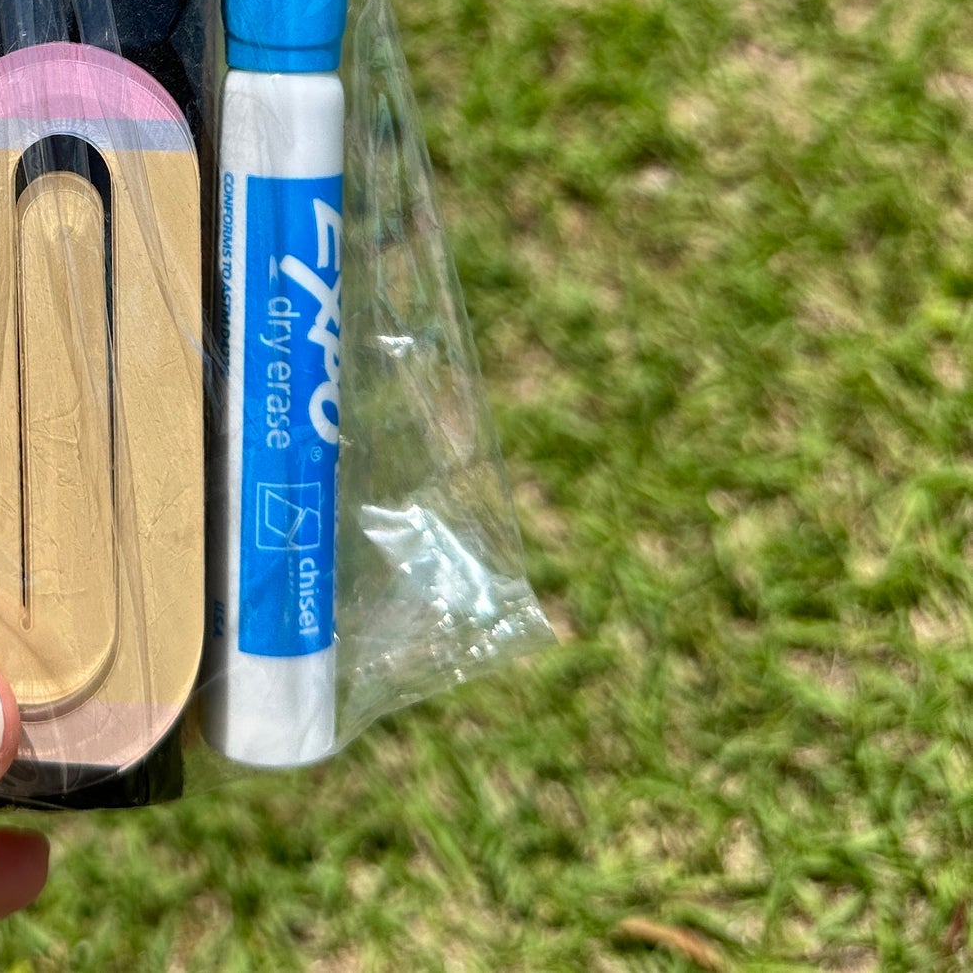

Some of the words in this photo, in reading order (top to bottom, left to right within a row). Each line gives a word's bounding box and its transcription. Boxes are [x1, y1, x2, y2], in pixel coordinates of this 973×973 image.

[222, 171, 235, 256] CONFORMS
[220, 281, 232, 325] ASTM
[222, 260, 233, 280] TO
[259, 296, 301, 354] dry
[266, 361, 292, 449] erase
[298, 557, 321, 636] chisel
